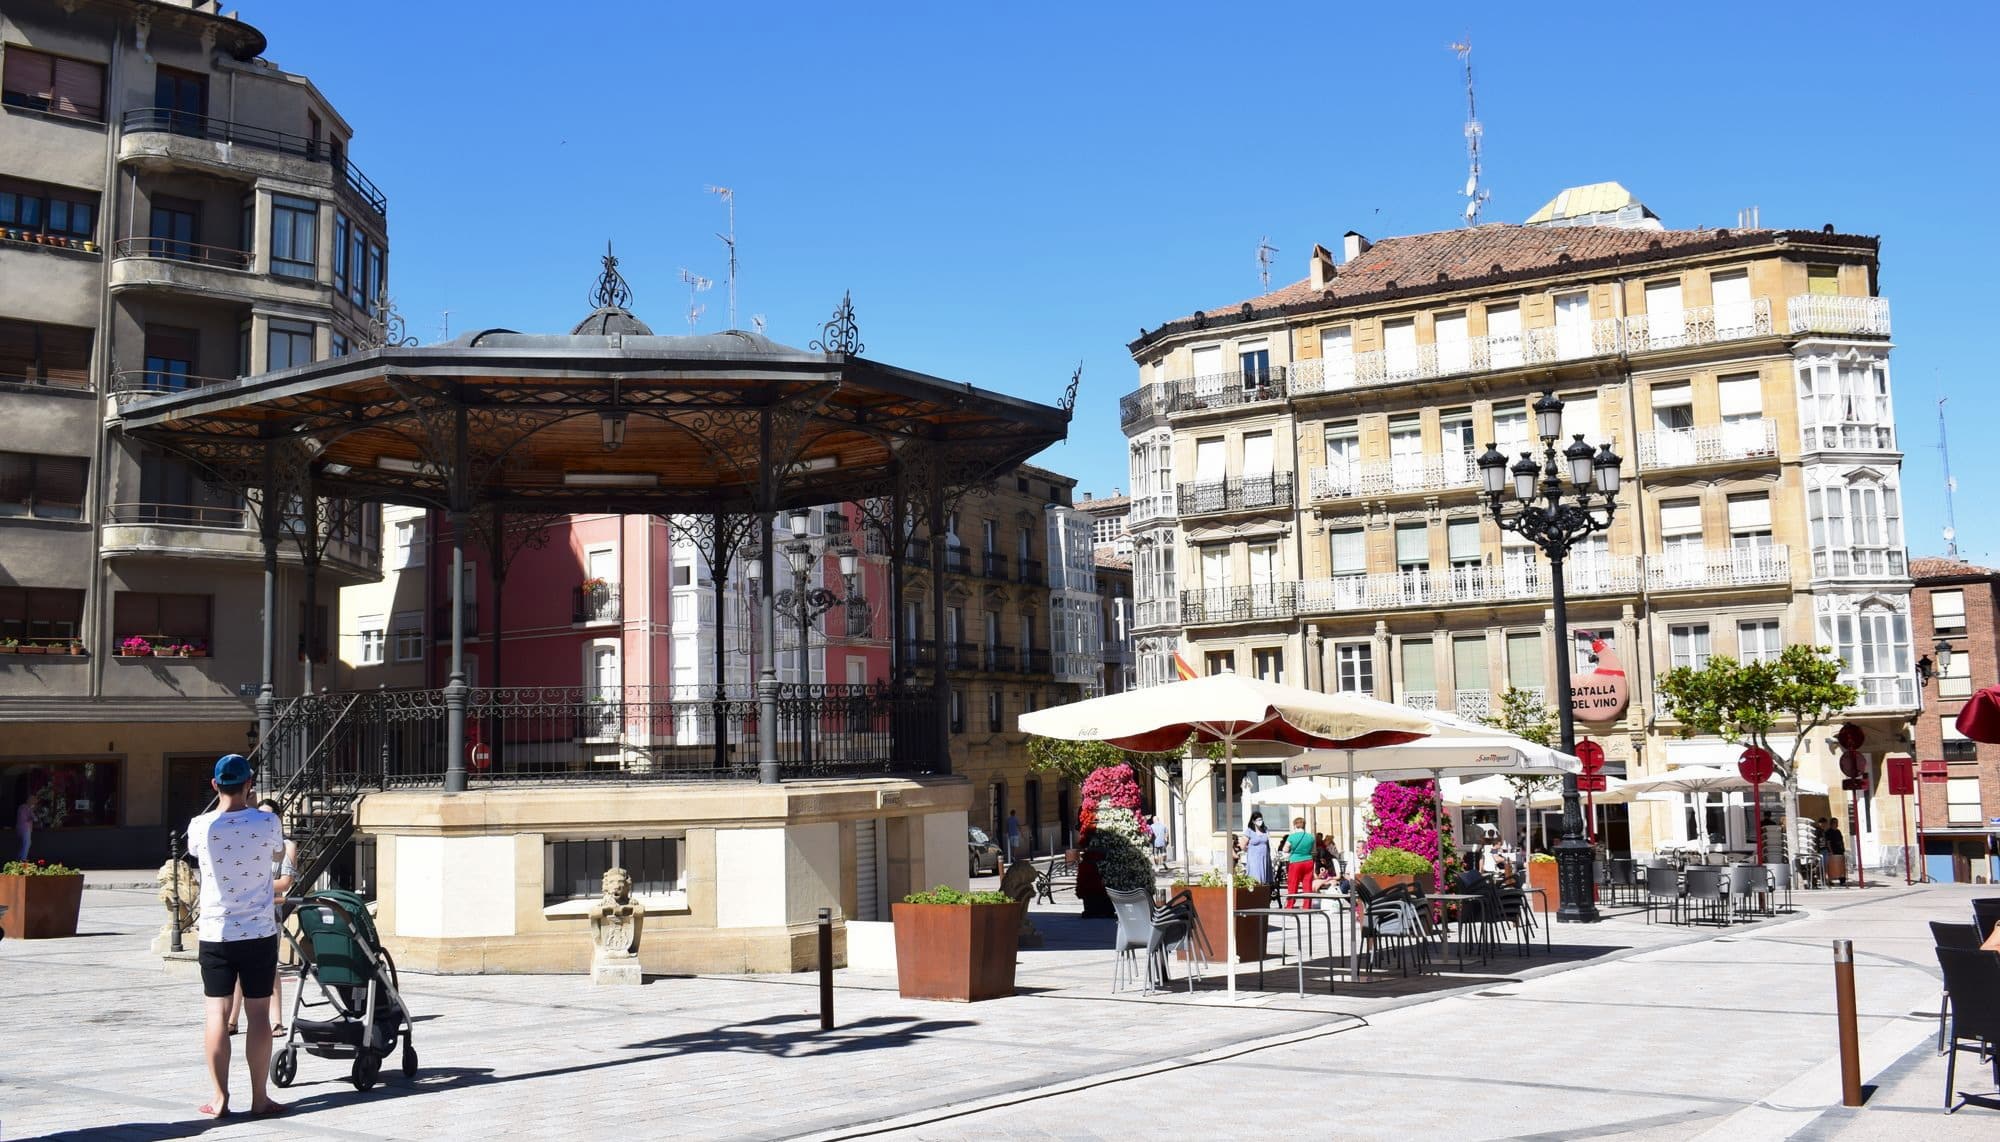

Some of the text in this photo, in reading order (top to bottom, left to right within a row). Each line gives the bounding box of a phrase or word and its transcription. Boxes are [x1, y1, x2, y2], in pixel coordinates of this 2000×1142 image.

[1570, 685, 1616, 697] BATALLA
[1571, 697, 1618, 709] DEL VINO
